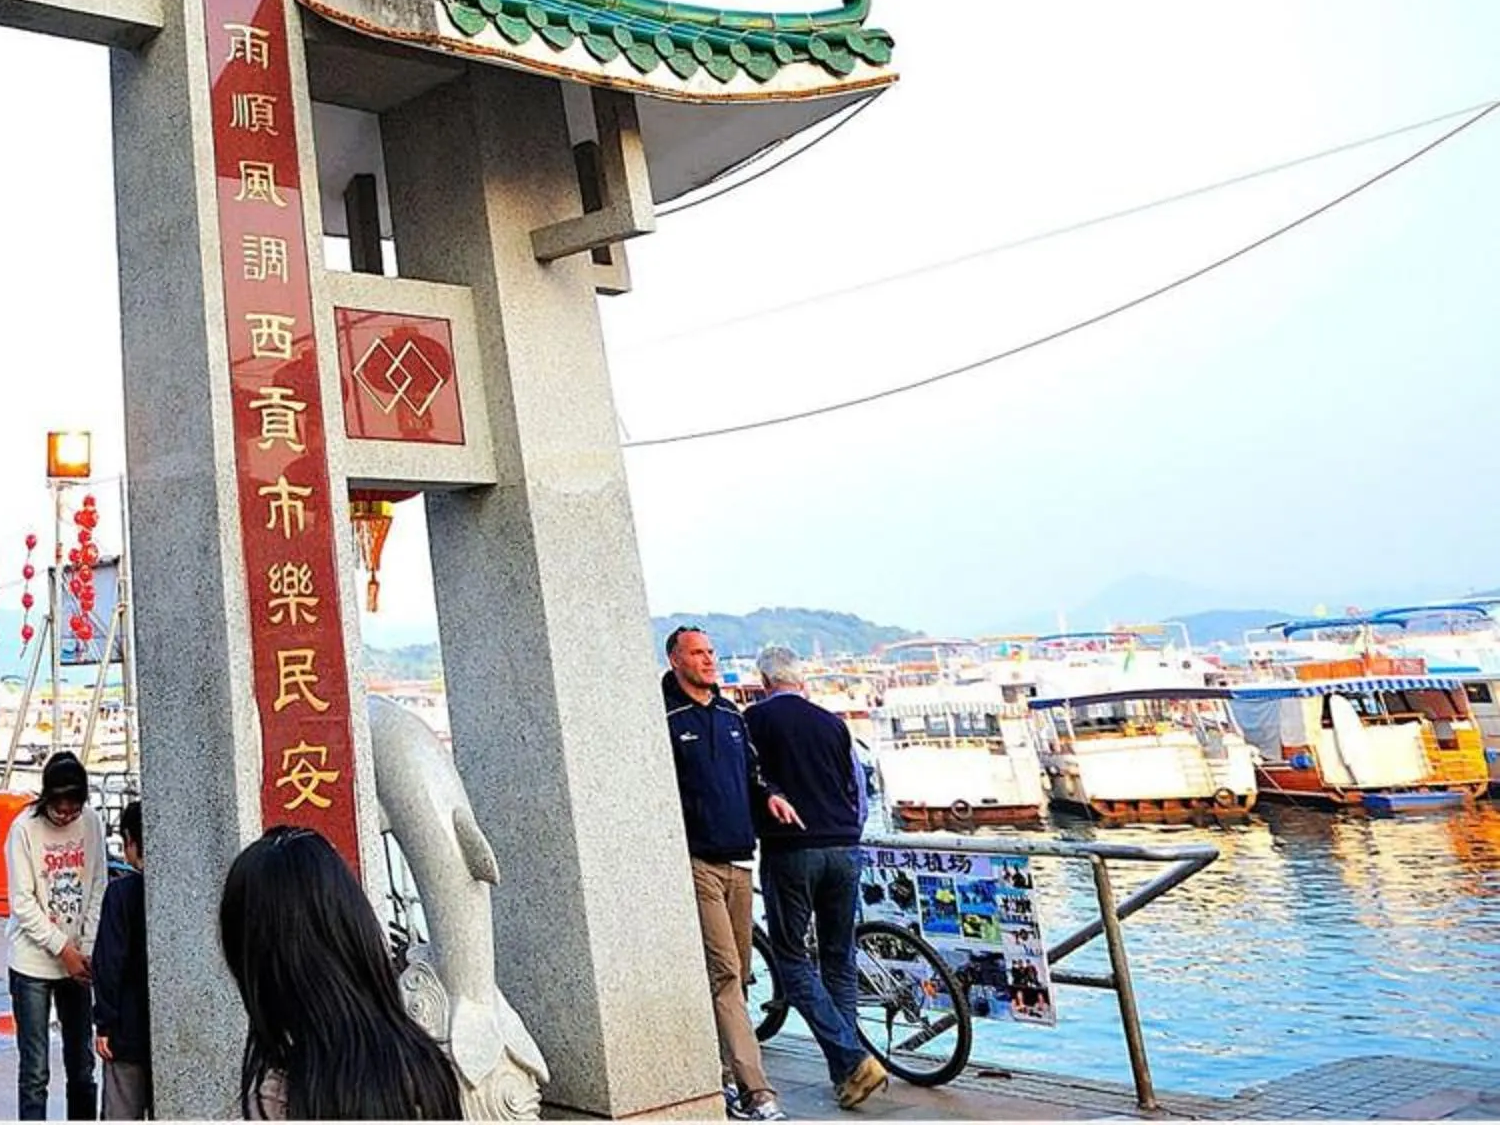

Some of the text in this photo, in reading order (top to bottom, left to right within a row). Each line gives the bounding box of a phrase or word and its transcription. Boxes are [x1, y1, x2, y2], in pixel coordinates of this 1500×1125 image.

[223, 22, 340, 811] 雨順風調西貢市樂民安
